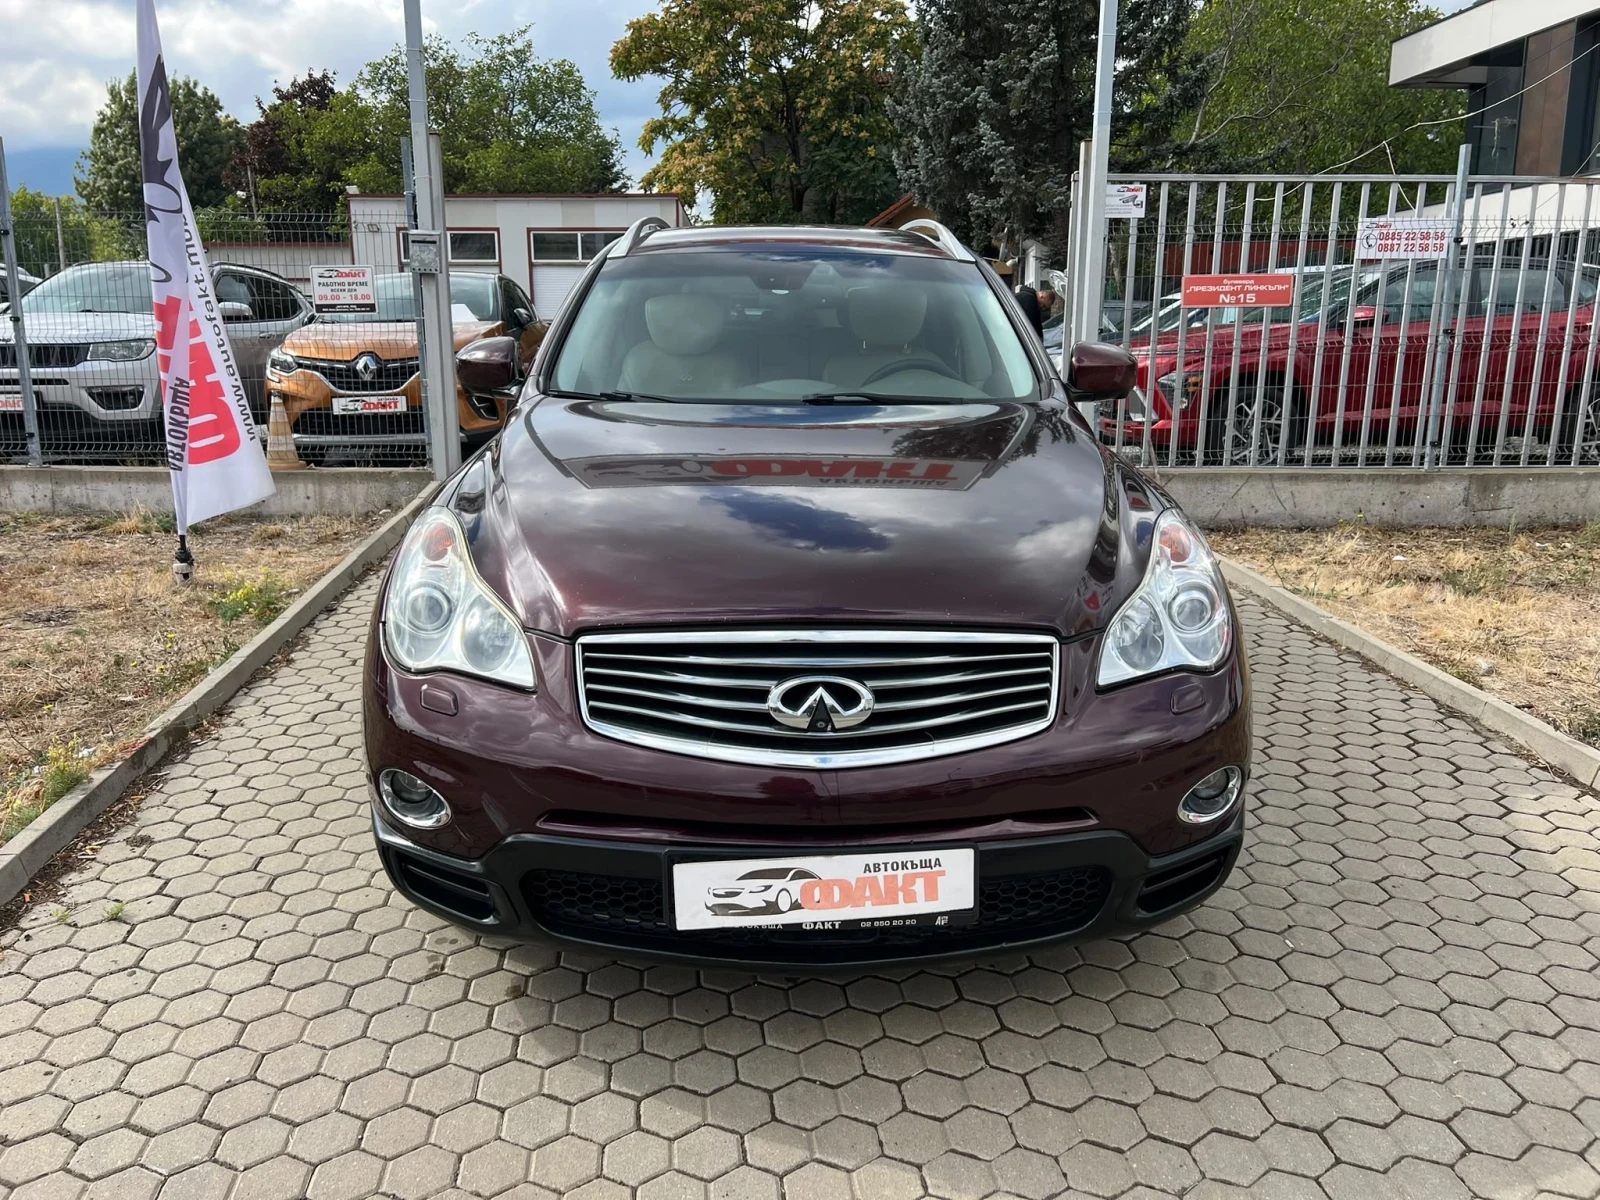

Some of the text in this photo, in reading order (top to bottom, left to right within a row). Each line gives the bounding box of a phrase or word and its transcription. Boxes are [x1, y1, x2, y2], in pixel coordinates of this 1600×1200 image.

[1379, 231, 1446, 241] 0885 22 58 58
[1377, 243, 1444, 253] 0887 22 58 58
[349, 293, 371, 301] 18.00
[863, 857, 943, 874] АВТОКЪЩА
[799, 869, 946, 911] ФАКТ
[801, 920, 842, 931] ФАКТ
